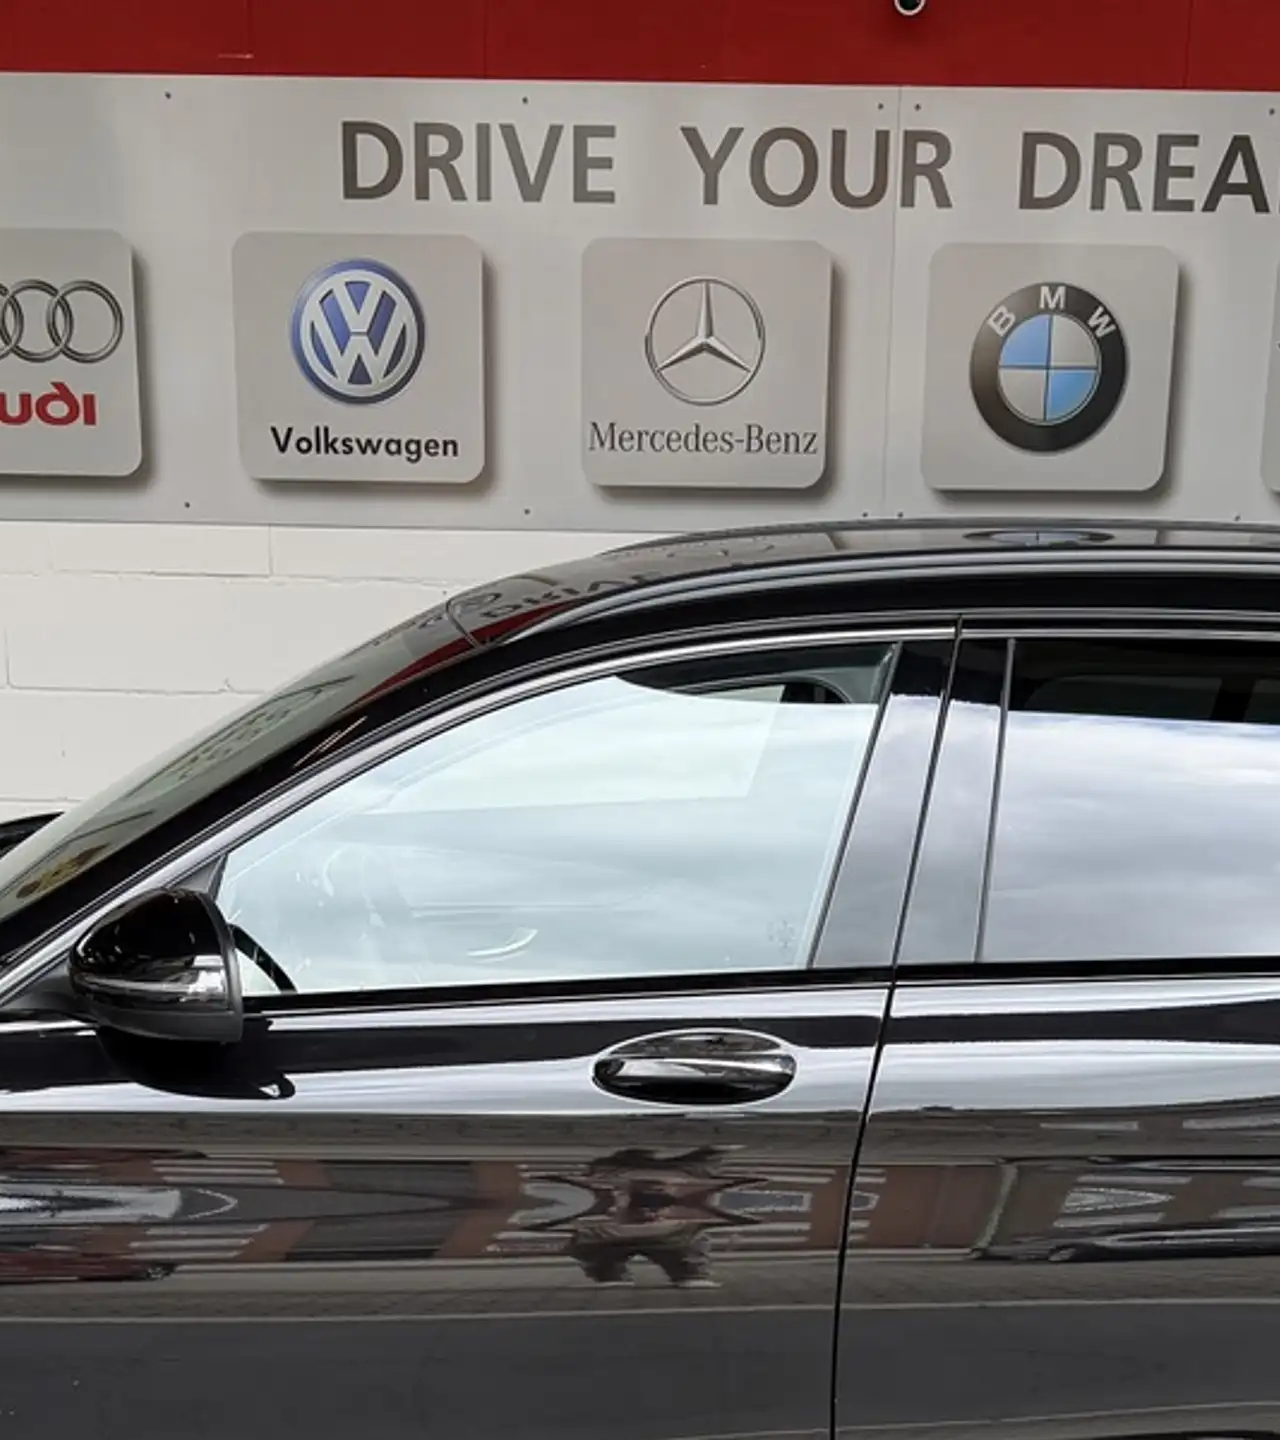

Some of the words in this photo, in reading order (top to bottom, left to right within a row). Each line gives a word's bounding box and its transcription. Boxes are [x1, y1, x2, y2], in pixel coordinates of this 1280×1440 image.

[341, 120, 616, 204] DRIVE
[680, 126, 953, 209] YOUR
[987, 284, 1117, 338] BMW
[270, 425, 458, 464] Volkswagen
[588, 421, 818, 455] Mercedes-Benz
